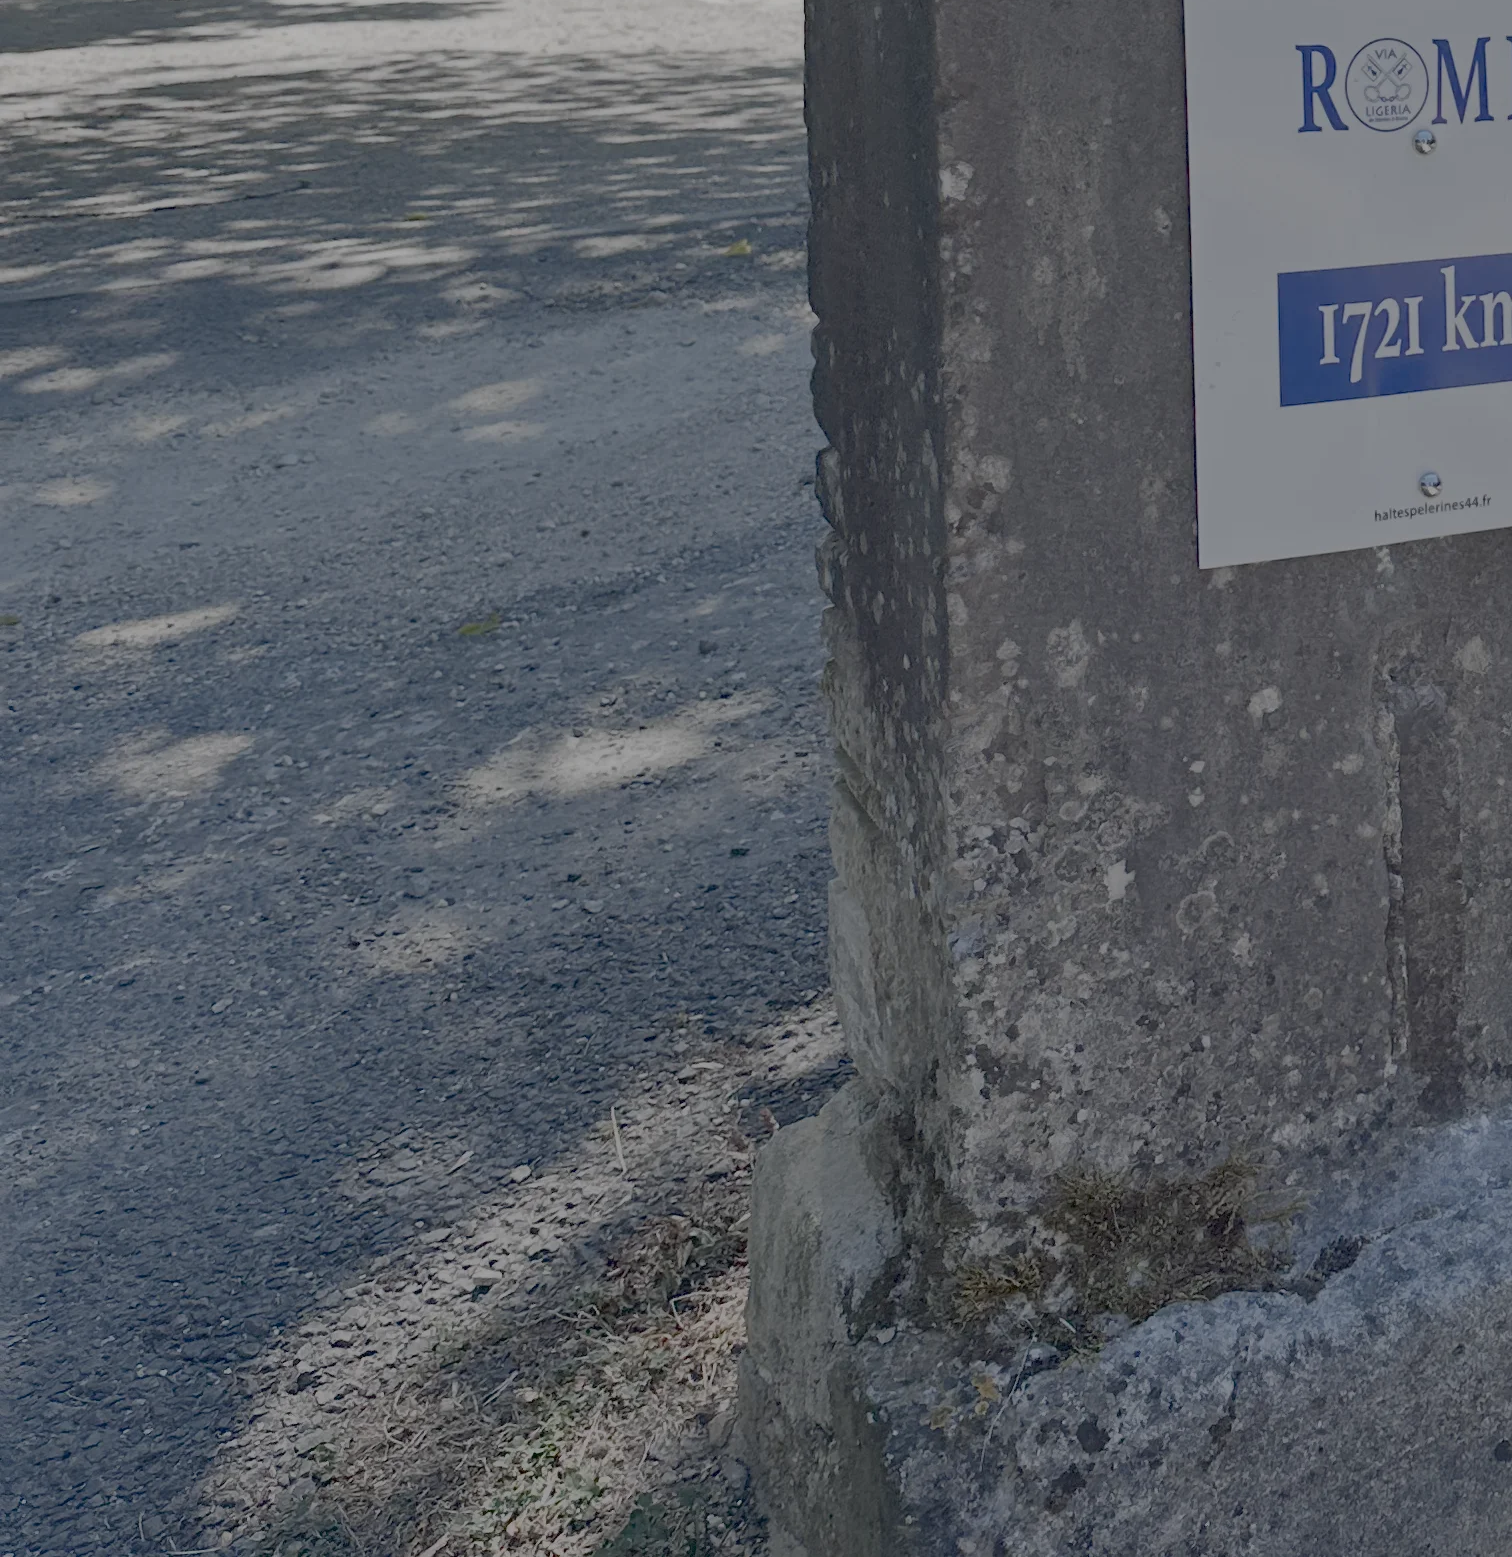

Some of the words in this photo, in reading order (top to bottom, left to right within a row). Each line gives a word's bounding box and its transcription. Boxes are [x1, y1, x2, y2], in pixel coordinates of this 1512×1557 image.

[1374, 48, 1398, 60] VIA
[1365, 104, 1412, 117] LIGERIA
[1318, 295, 1425, 383] 1721
[1374, 493, 1492, 522] haltespelerines44.fr
